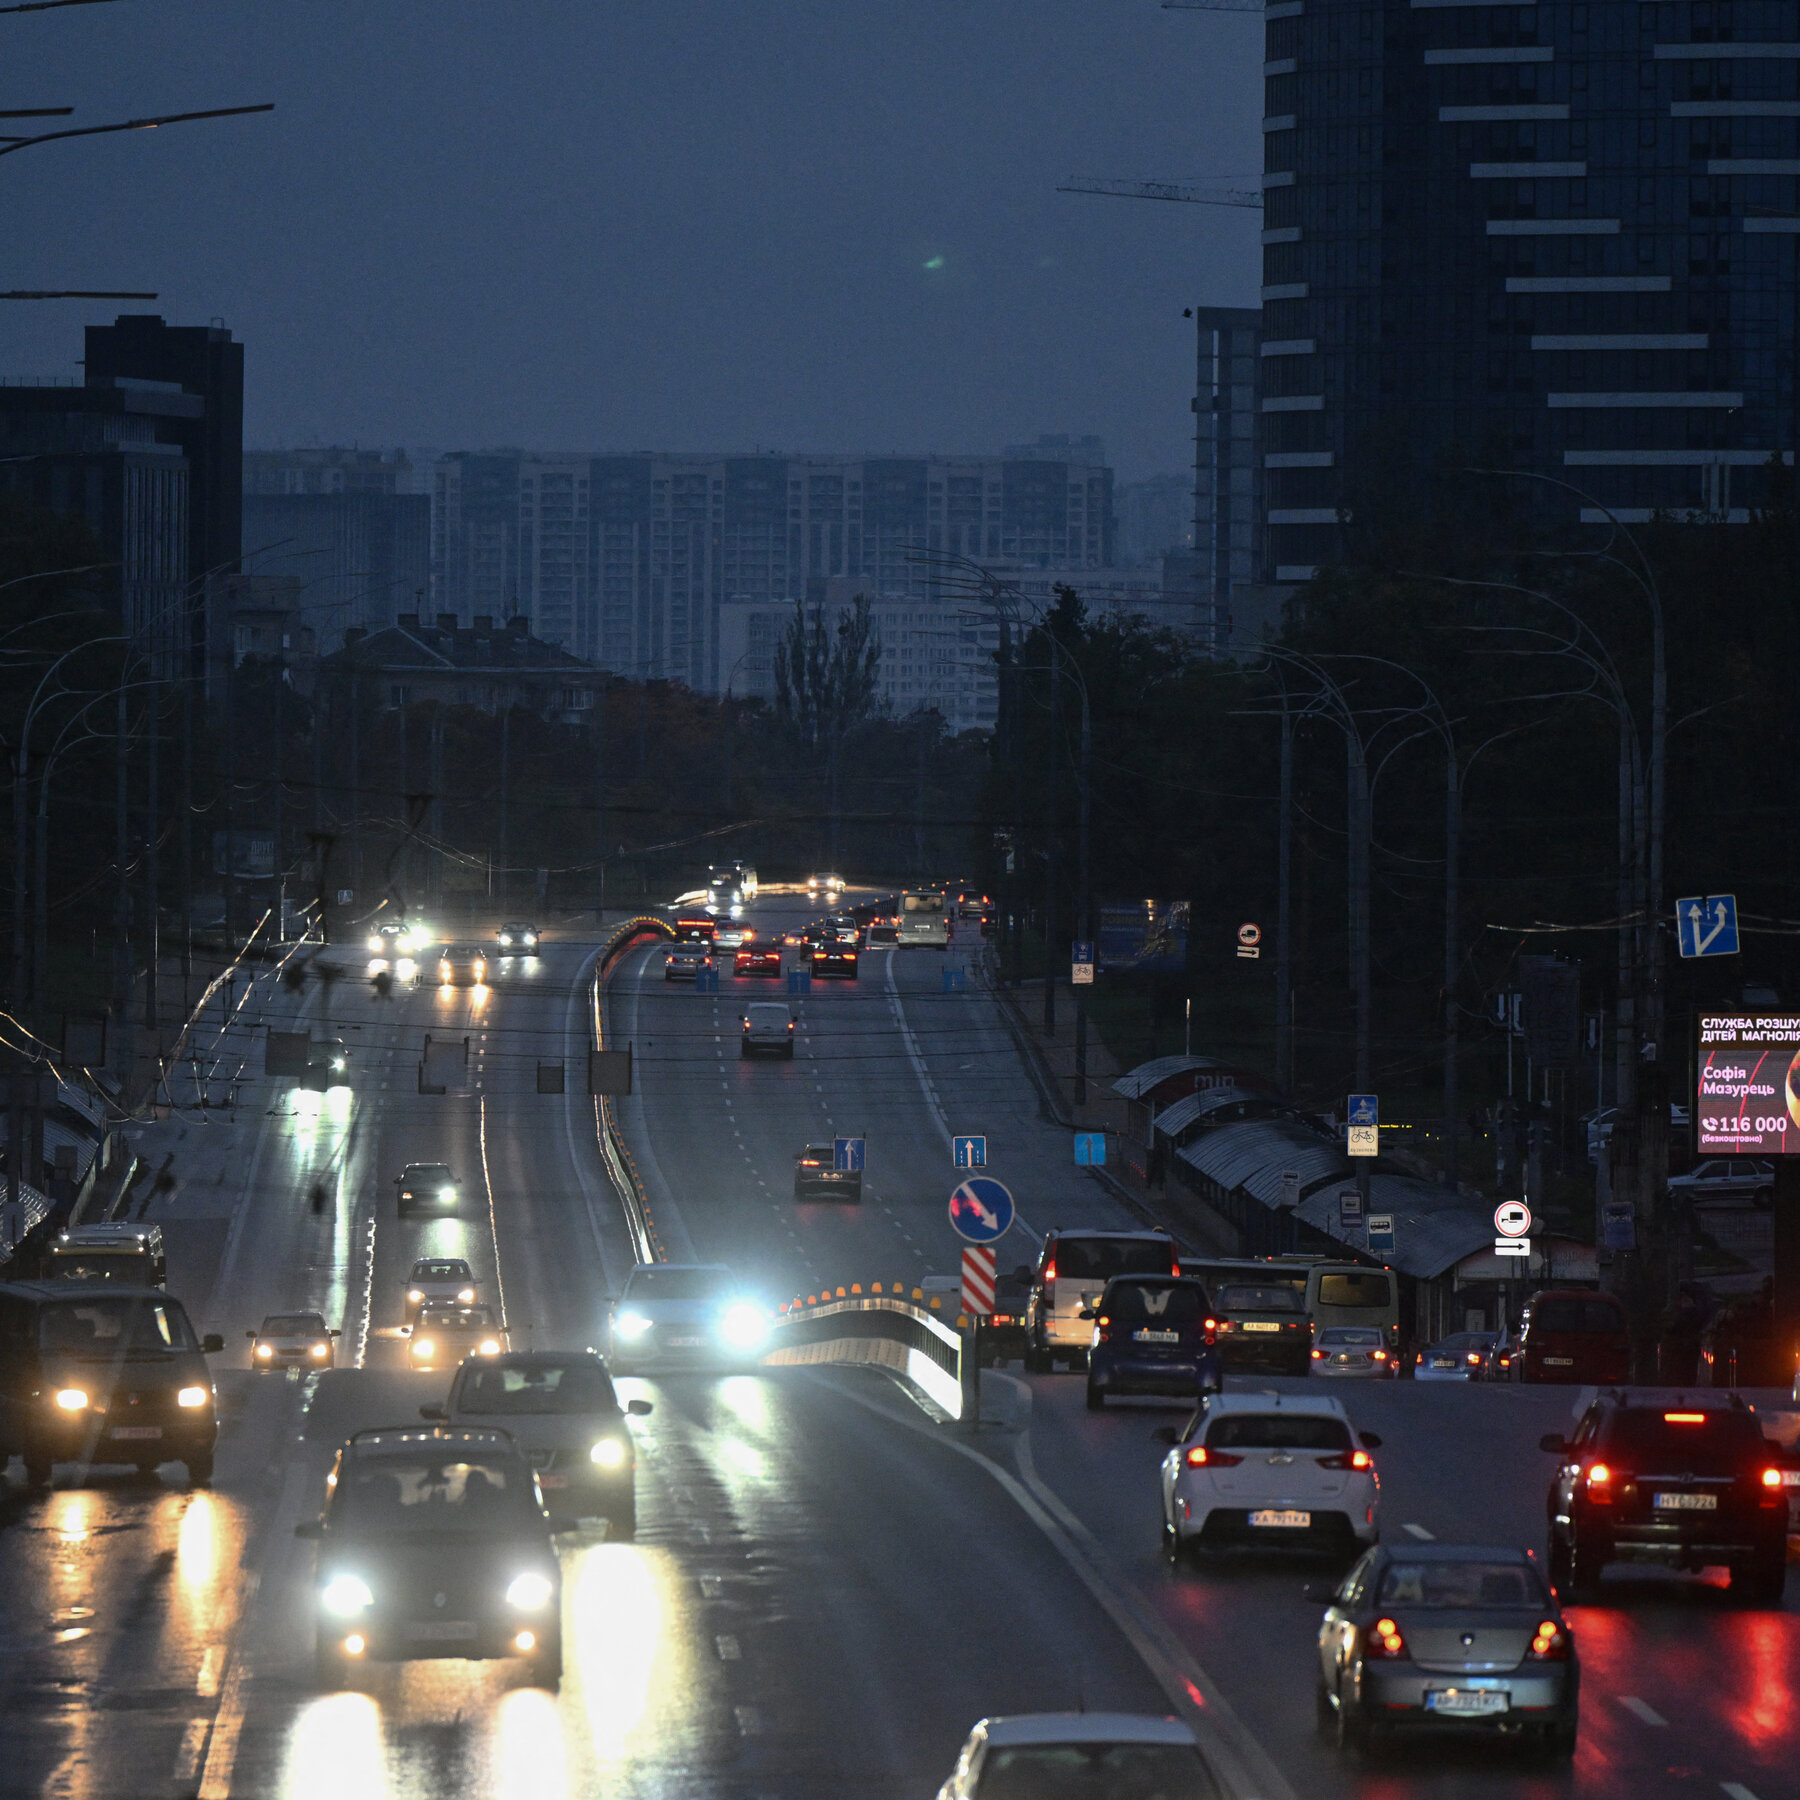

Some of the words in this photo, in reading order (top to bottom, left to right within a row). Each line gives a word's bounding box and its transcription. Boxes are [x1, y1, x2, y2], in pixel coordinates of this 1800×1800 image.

[1701, 1018, 1753, 1029] СЛУЖБА
[1756, 1018, 1800, 1029] РОЗШУ
[1701, 1029, 1737, 1042] ДІТЕЙ
[1703, 1066, 1746, 1081] Софія
[1703, 1082, 1775, 1097] Мазурець
[1720, 1117, 1751, 1132] 116
[1755, 1117, 1787, 1132] 000
[1702, 1134, 1763, 1143] (безкоштовно)
